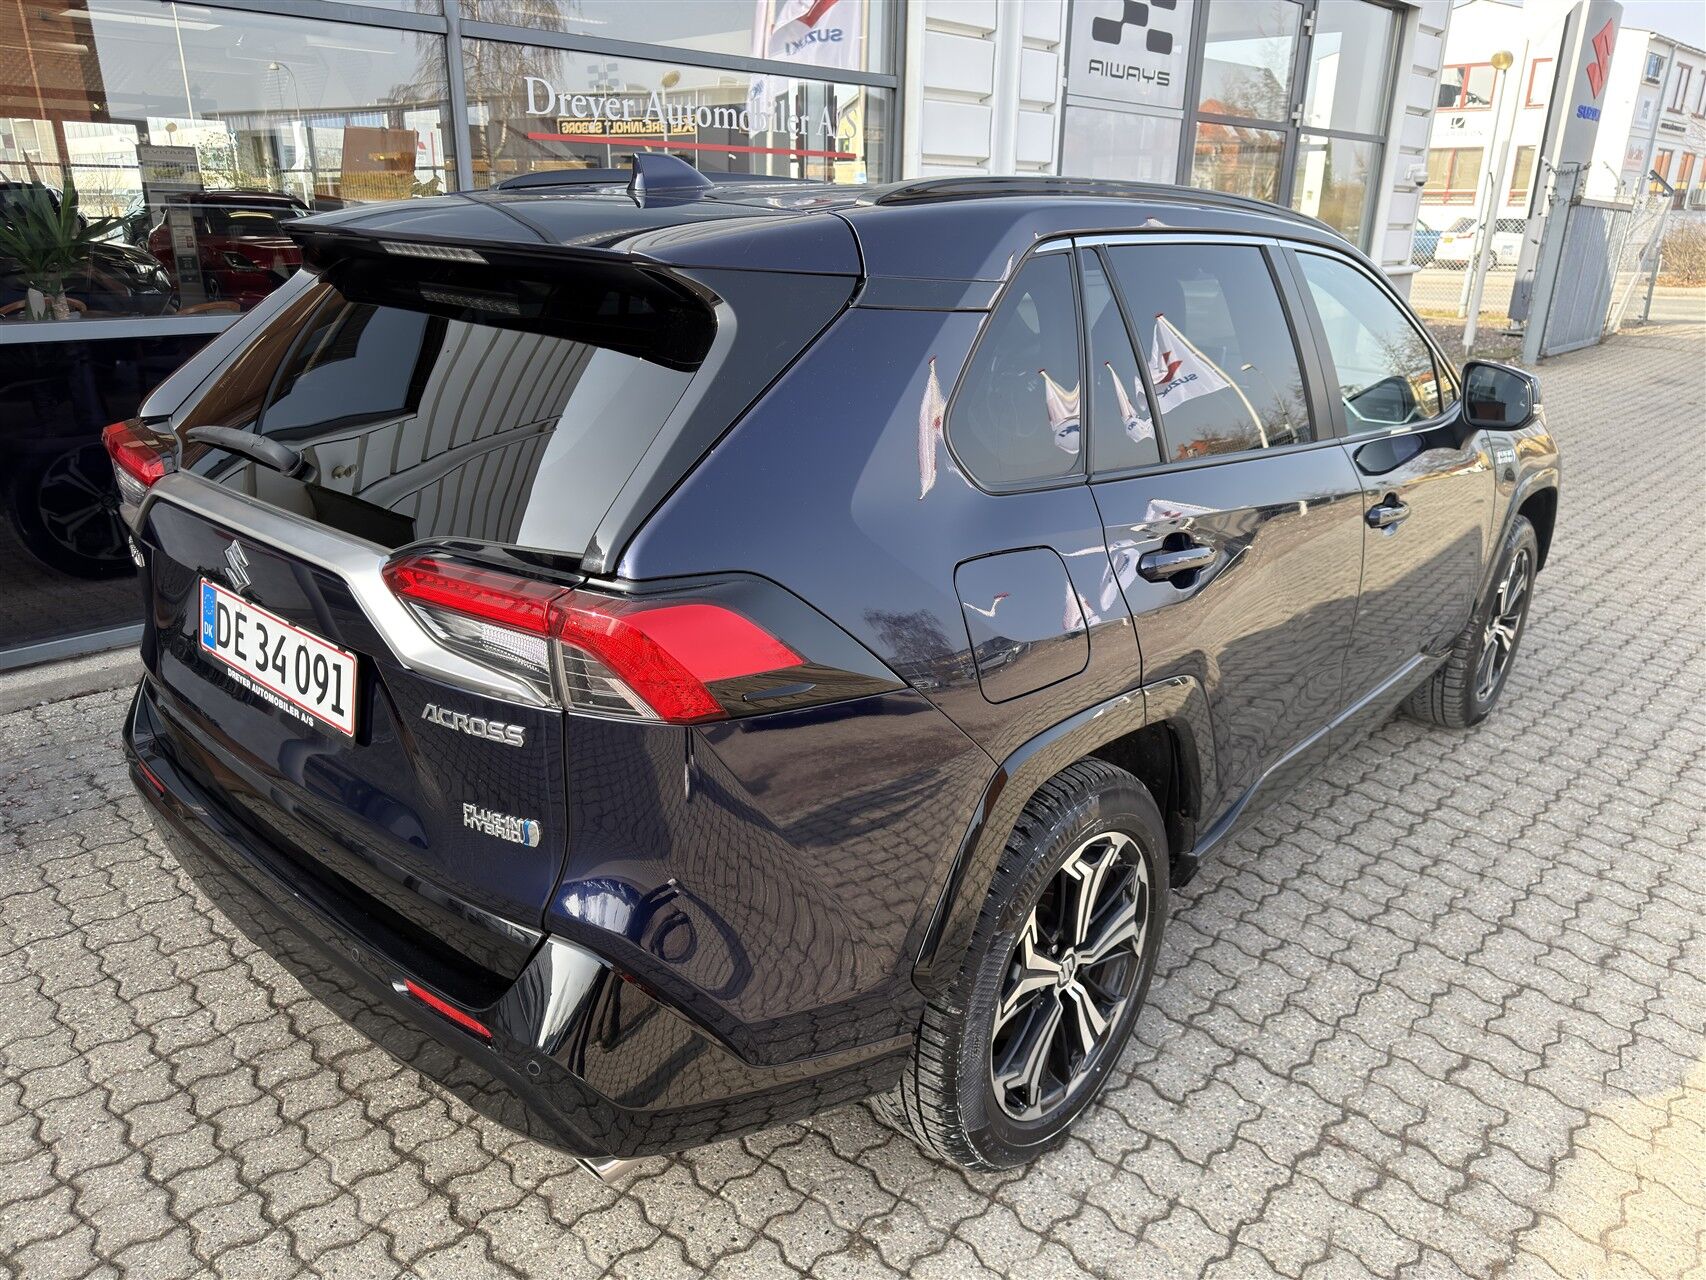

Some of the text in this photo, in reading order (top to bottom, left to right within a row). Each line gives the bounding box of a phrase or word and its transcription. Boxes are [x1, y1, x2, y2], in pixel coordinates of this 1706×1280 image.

[1089, 59, 1170, 87] AIWAYS
[523, 76, 634, 126] Dreyer
[643, 88, 809, 136] Automobiler
[203, 621, 214, 639] DK
[217, 601, 345, 718] DE 34 091
[227, 667, 314, 728] DREYER AUTOMOBILER A/S
[421, 703, 527, 748] ACROSS
[462, 802, 523, 833] PLUG-IN
[463, 812, 524, 845] HYBRID
